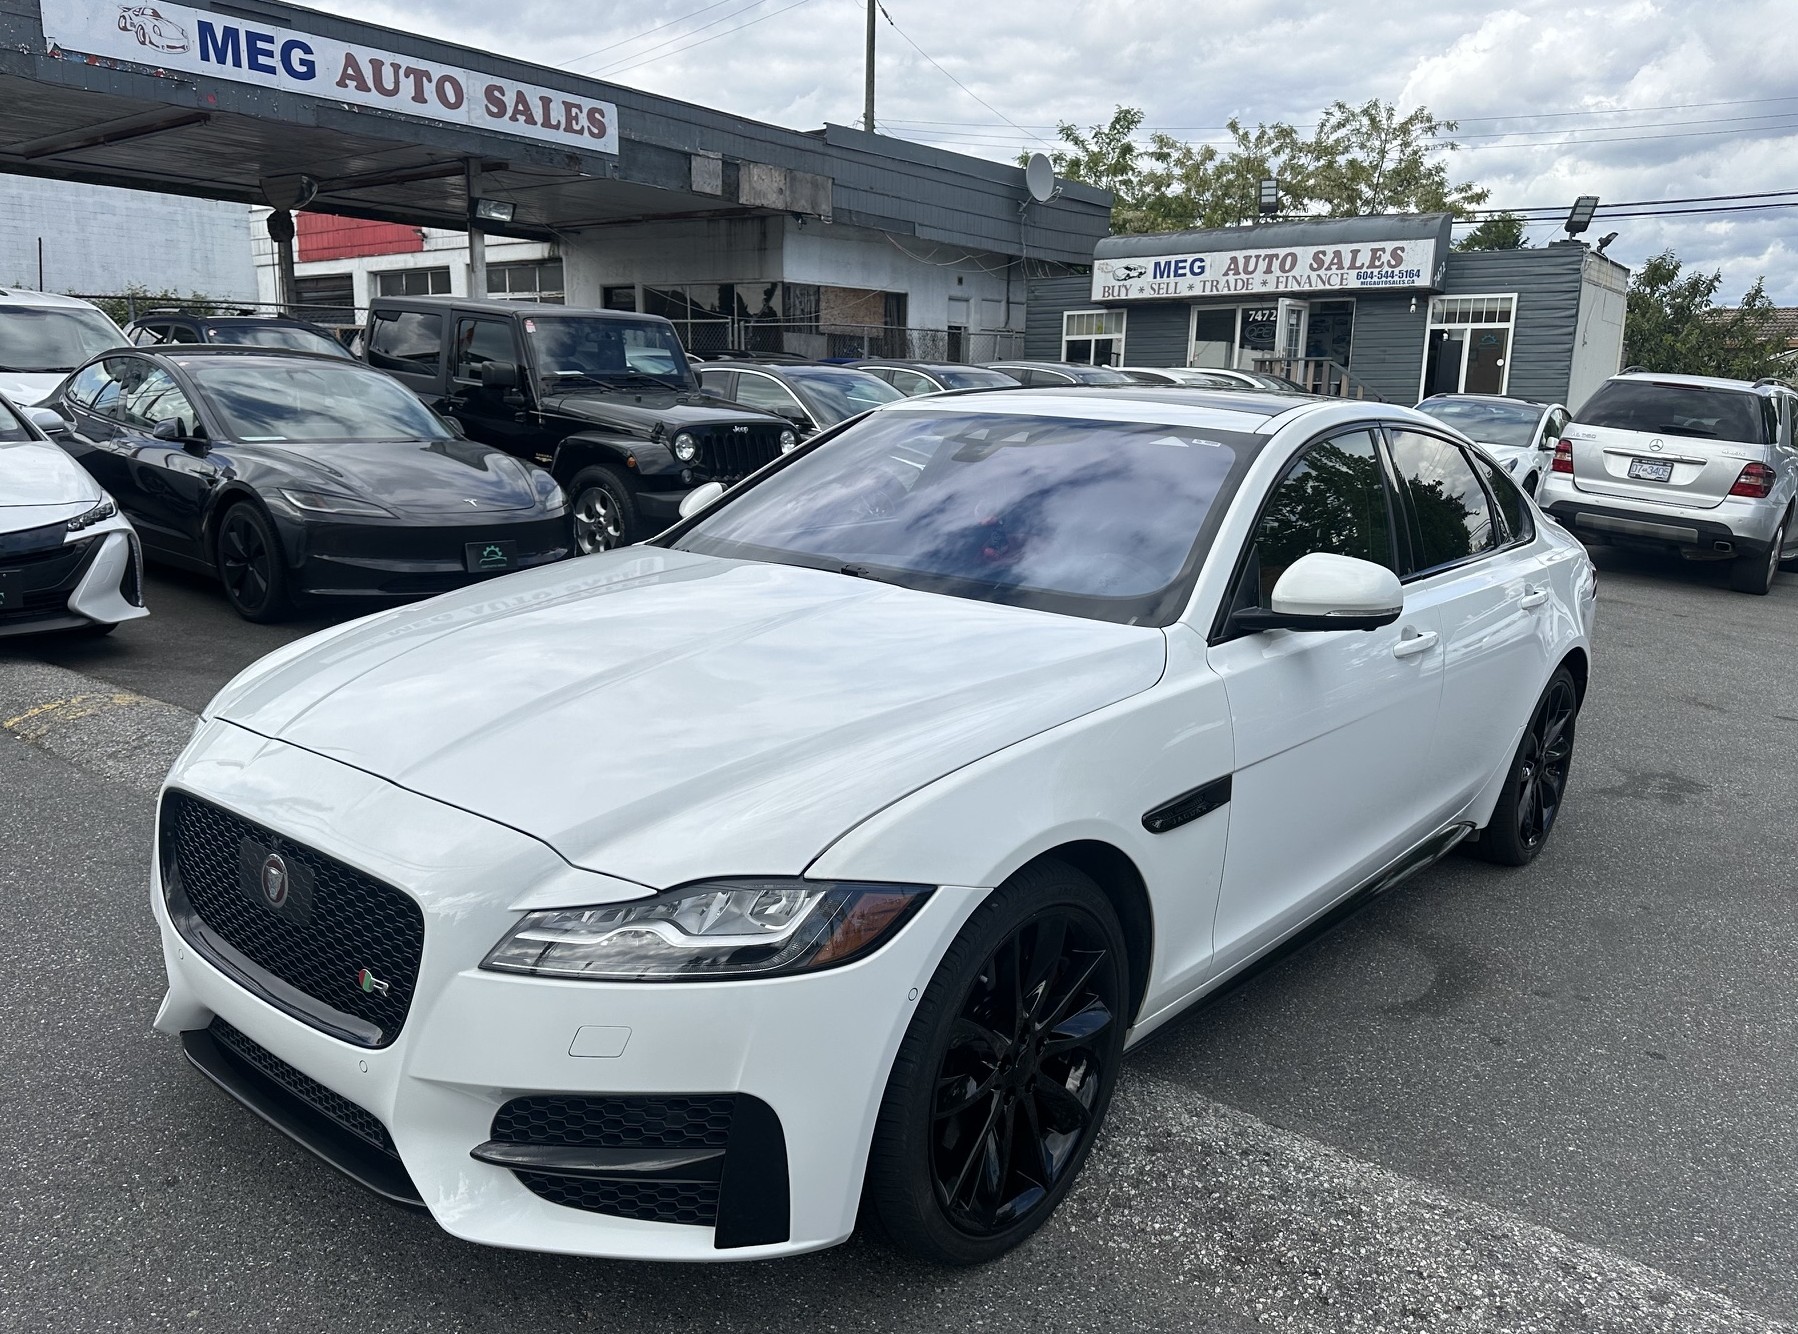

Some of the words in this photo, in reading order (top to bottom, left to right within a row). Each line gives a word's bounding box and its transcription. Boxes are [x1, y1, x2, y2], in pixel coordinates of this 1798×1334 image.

[198, 19, 316, 81] MEG
[336, 52, 464, 110] AUTO
[484, 84, 607, 140] SALES
[1152, 257, 1206, 280] MEG
[1222, 251, 1298, 277] AUTO
[1309, 246, 1406, 272] SALES
[1356, 268, 1421, 281] 604-544-5164
[1102, 283, 1132, 298] BUY
[1149, 281, 1181, 296] SELL
[1200, 277, 1254, 293] TRADE
[1275, 272, 1349, 290] FINANCE
[1360, 278, 1415, 287] MEGAUTOSALES.CA
[1249, 309, 1277, 321] 7472
[732, 425, 749, 435] Jeep
[1173, 807, 1207, 825] JAGUAR
